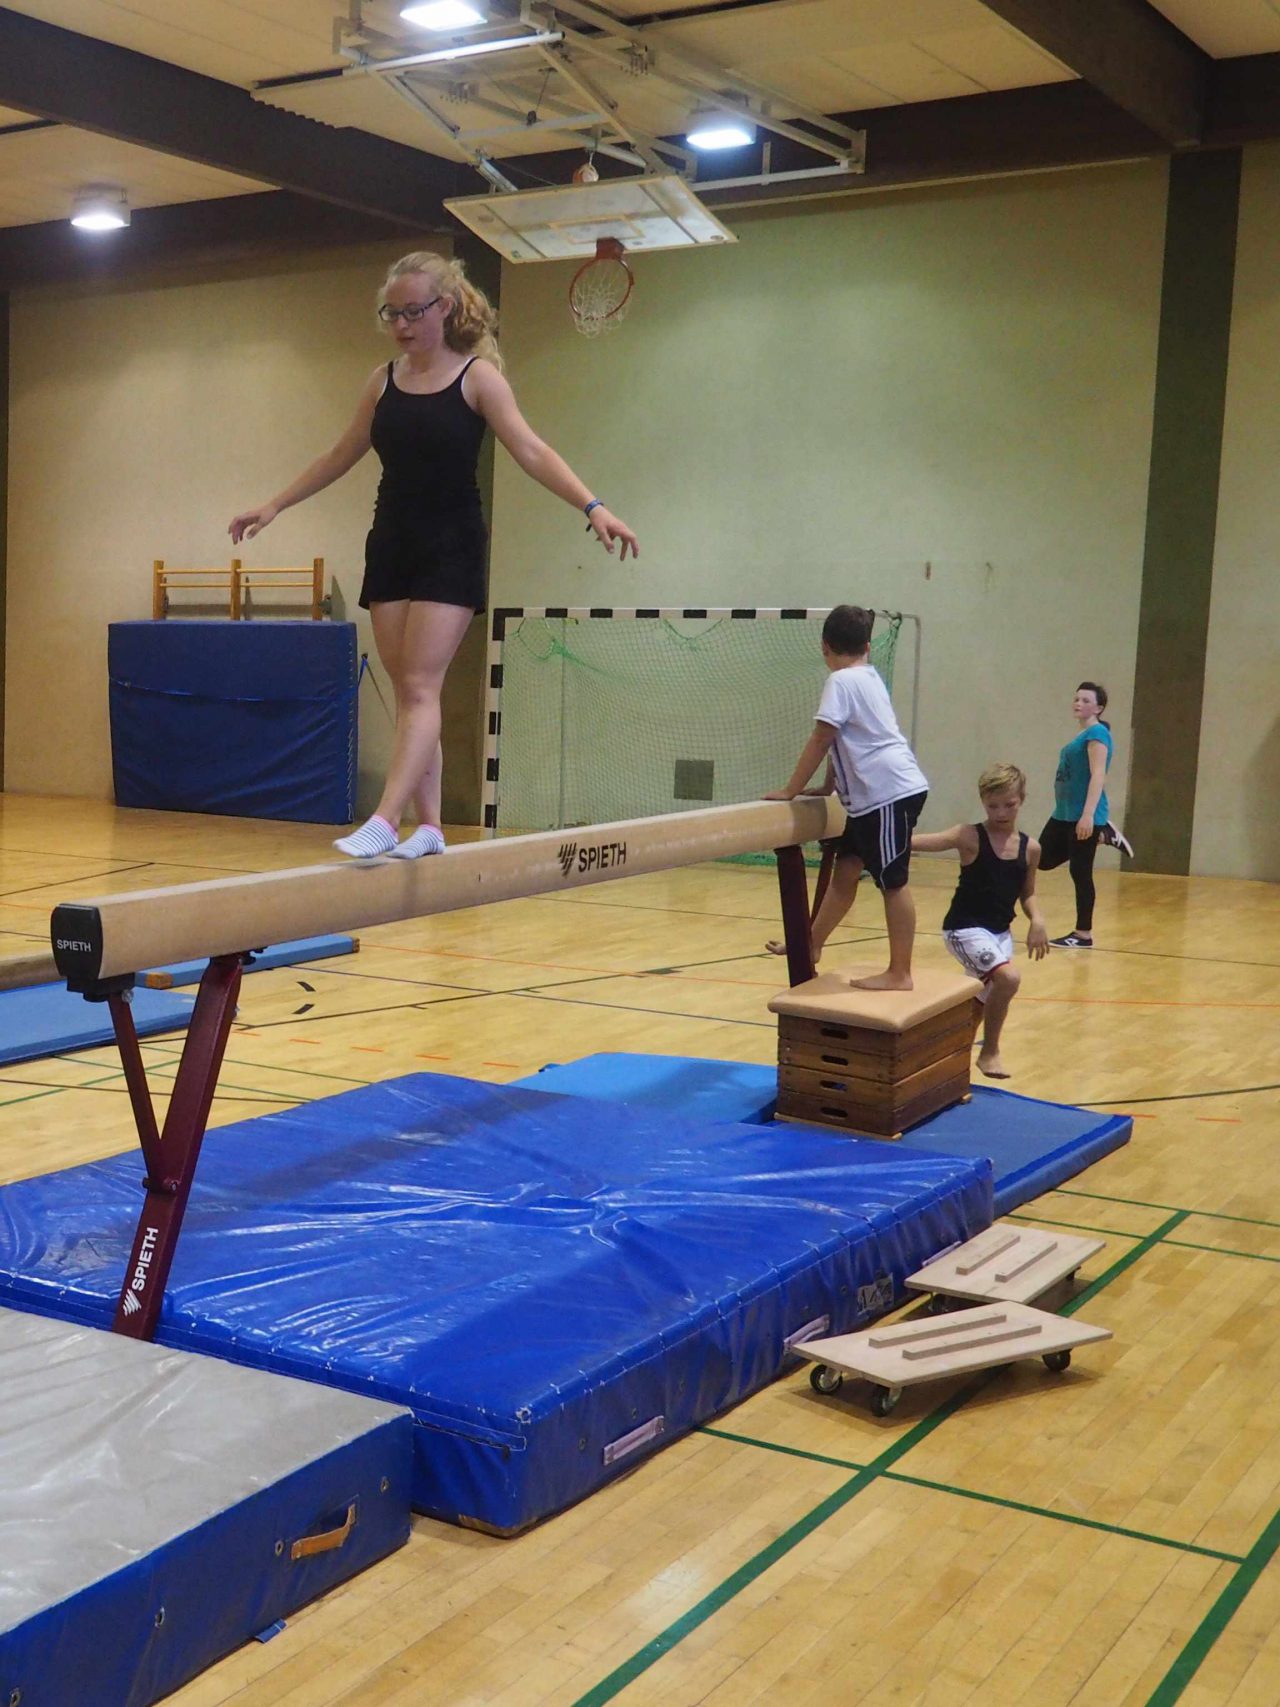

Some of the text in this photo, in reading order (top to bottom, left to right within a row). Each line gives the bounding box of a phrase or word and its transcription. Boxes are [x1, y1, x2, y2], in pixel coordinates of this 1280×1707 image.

[578, 841, 627, 873] SPIETH
[56, 939, 92, 952] SPIETH
[131, 1227, 159, 1291] SPIETH
